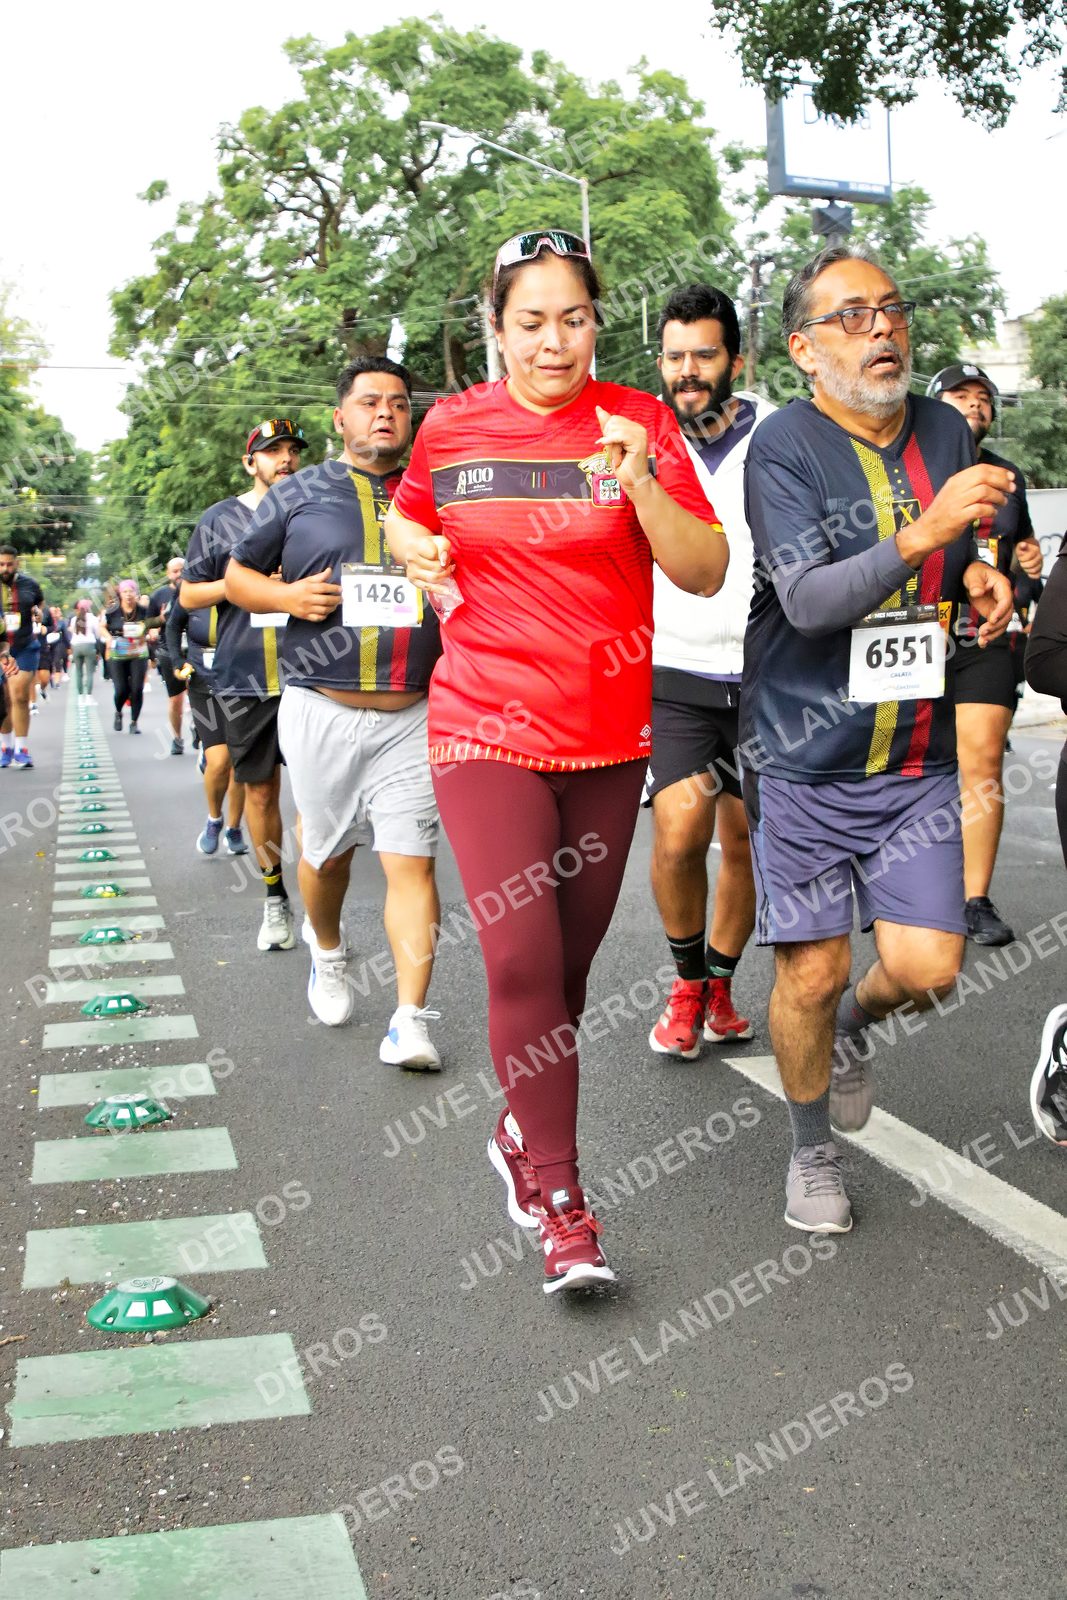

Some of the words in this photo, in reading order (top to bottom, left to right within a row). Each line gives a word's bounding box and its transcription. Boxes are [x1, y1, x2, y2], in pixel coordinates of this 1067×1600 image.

[467, 467, 494, 485] 100
[354, 583, 405, 603] 1426
[866, 634, 933, 669] 6551
